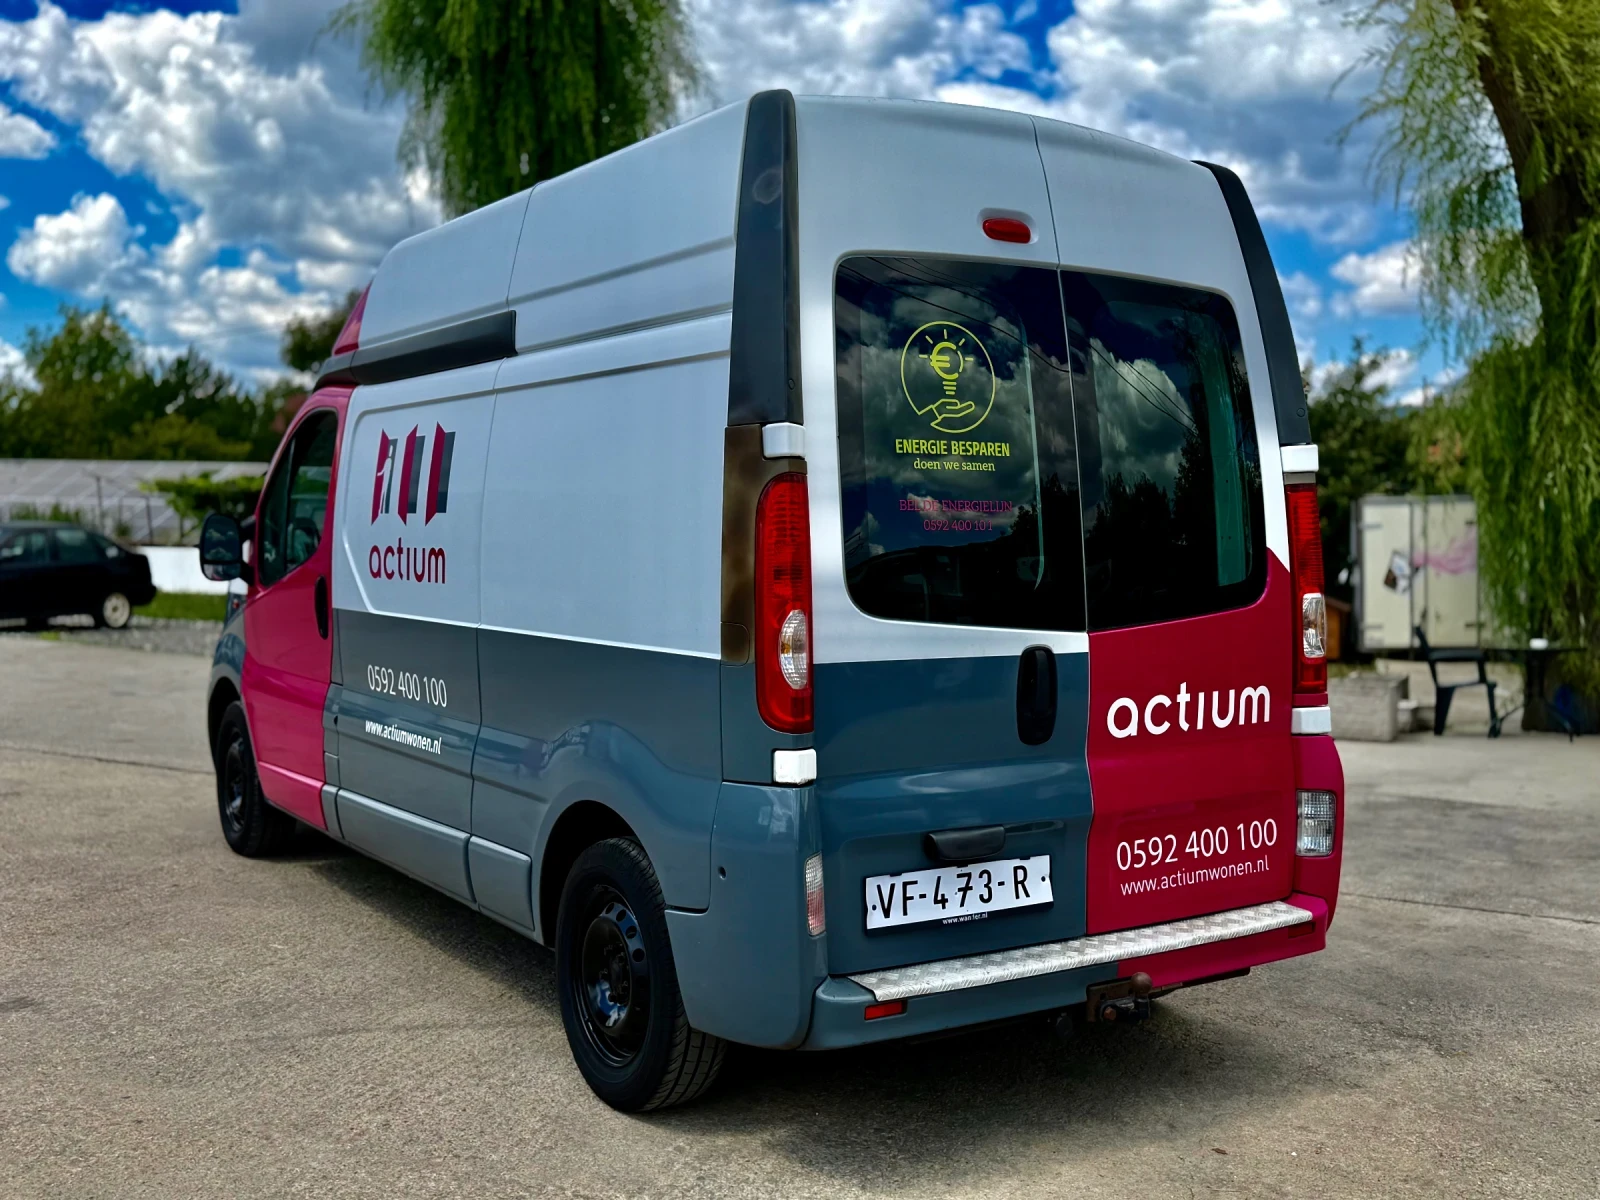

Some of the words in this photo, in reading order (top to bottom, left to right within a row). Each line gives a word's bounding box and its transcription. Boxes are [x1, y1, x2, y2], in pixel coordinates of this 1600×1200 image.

[895, 438, 948, 455] ENERGIE
[951, 440, 1011, 457] BESPAREN
[913, 457, 941, 470] doen
[943, 461, 960, 471] we
[961, 460, 996, 472] samen
[899, 499, 921, 512] BEL
[924, 500, 939, 512] DE
[942, 500, 1013, 513] ENERGIELIJN
[923, 519, 949, 531] 0592
[951, 520, 972, 531] 400
[974, 520, 993, 531] 101
[368, 536, 446, 584] actium
[367, 664, 397, 696] 0592
[398, 670, 421, 702] 400
[423, 676, 448, 708] 100
[1106, 681, 1271, 739] actium
[365, 719, 442, 755] www.actiumwonen.nl
[1116, 834, 1178, 871] 0592
[1184, 826, 1229, 859] 400
[1236, 818, 1278, 851] 100
[1120, 854, 1270, 896] www.actiumwonen.nl
